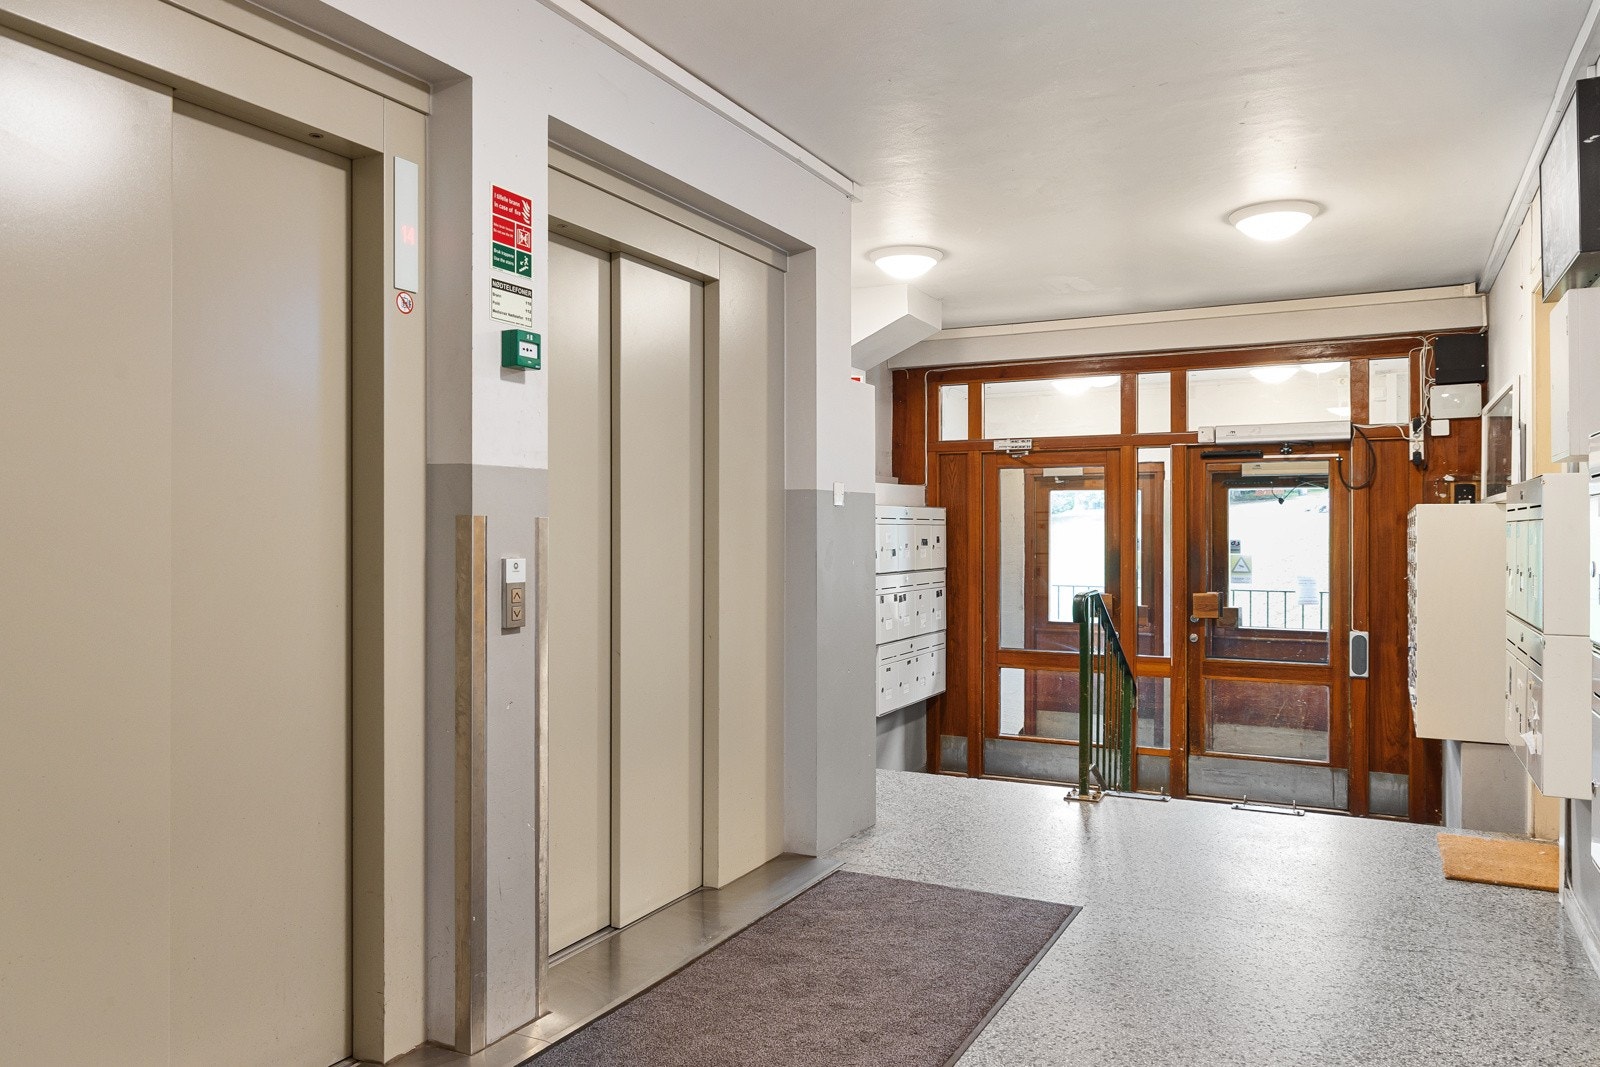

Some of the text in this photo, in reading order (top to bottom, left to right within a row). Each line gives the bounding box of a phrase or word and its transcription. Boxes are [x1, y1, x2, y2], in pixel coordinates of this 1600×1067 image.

[498, 204, 508, 212] case
[508, 198, 520, 208] brann
[492, 280, 532, 297] NØDTELEFONER
